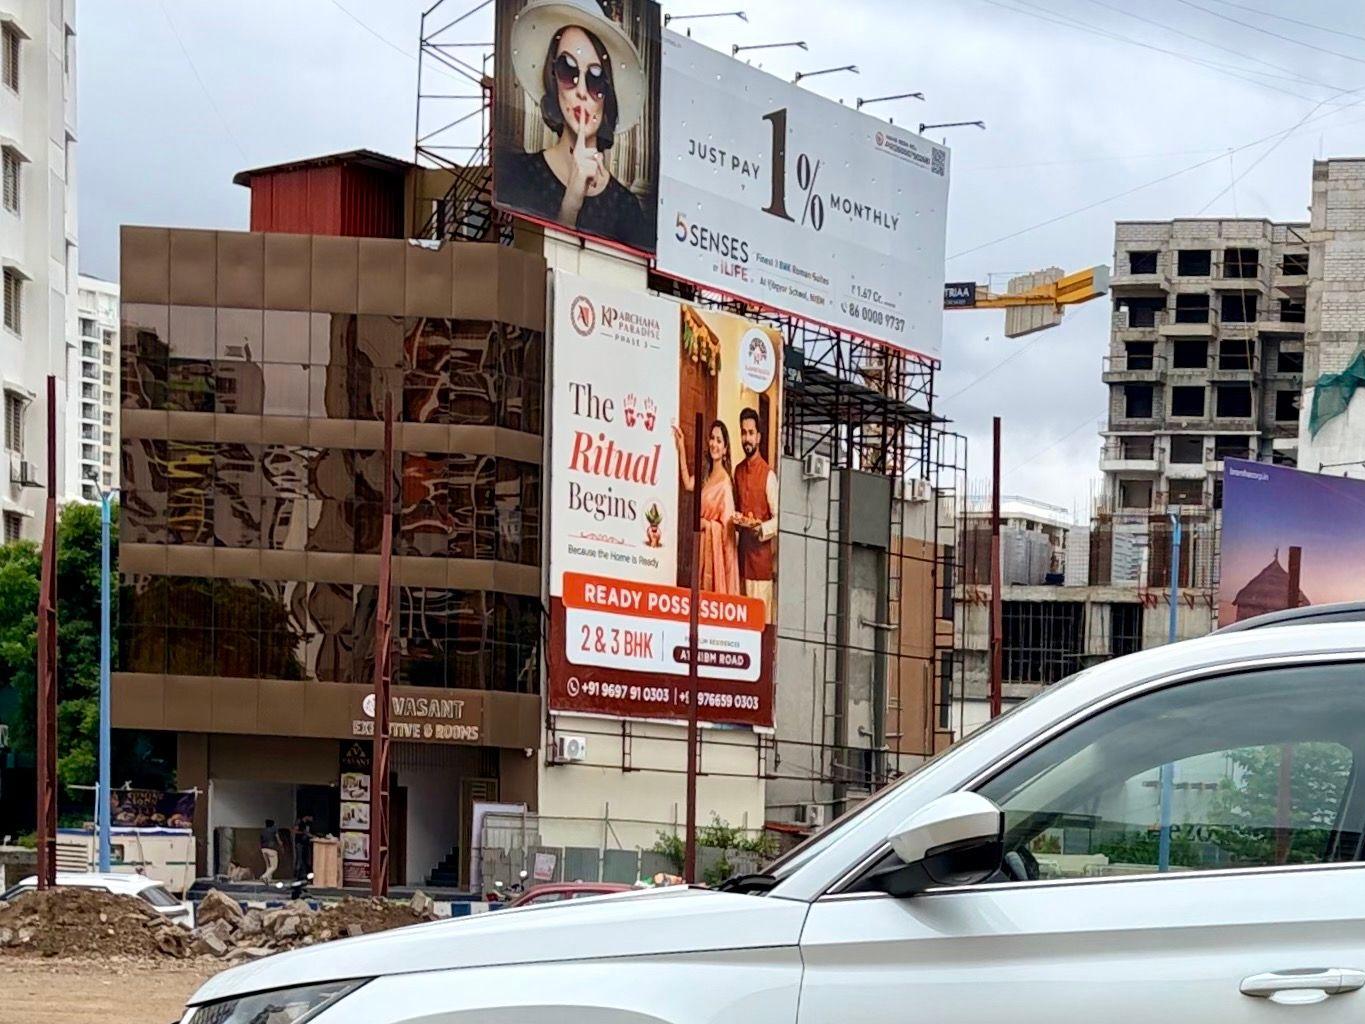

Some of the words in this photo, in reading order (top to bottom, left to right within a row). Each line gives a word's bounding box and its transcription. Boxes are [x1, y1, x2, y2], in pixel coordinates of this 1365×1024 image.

[688, 139, 727, 167] JUST
[731, 156, 760, 180] PAY
[830, 193, 899, 231] MONTHLY
[689, 224, 749, 264] SENSES
[849, 303, 860, 319] 86
[862, 306, 883, 326] 0000
[885, 315, 905, 333] 9737
[568, 382, 614, 423] The
[568, 430, 662, 486] Ritual
[568, 481, 637, 522] Begins
[568, 544, 596, 558] Because
[610, 551, 630, 563] Home
[639, 556, 659, 569] Ready
[584, 583, 642, 611] READY
[648, 593, 748, 623] POSSSSION
[581, 624, 591, 652] 2
[594, 625, 606, 654] &
[611, 628, 620, 655] 3
[624, 630, 653, 659] BHK
[719, 653, 744, 666] ROAD
[391, 697, 464, 719] VASANT
[582, 681, 599, 696] +91
[601, 682, 628, 699] 9697
[630, 686, 641, 701] 91
[643, 687, 669, 702] 0303
[734, 695, 760, 710] 0303
[435, 723, 479, 740] ROOMS
